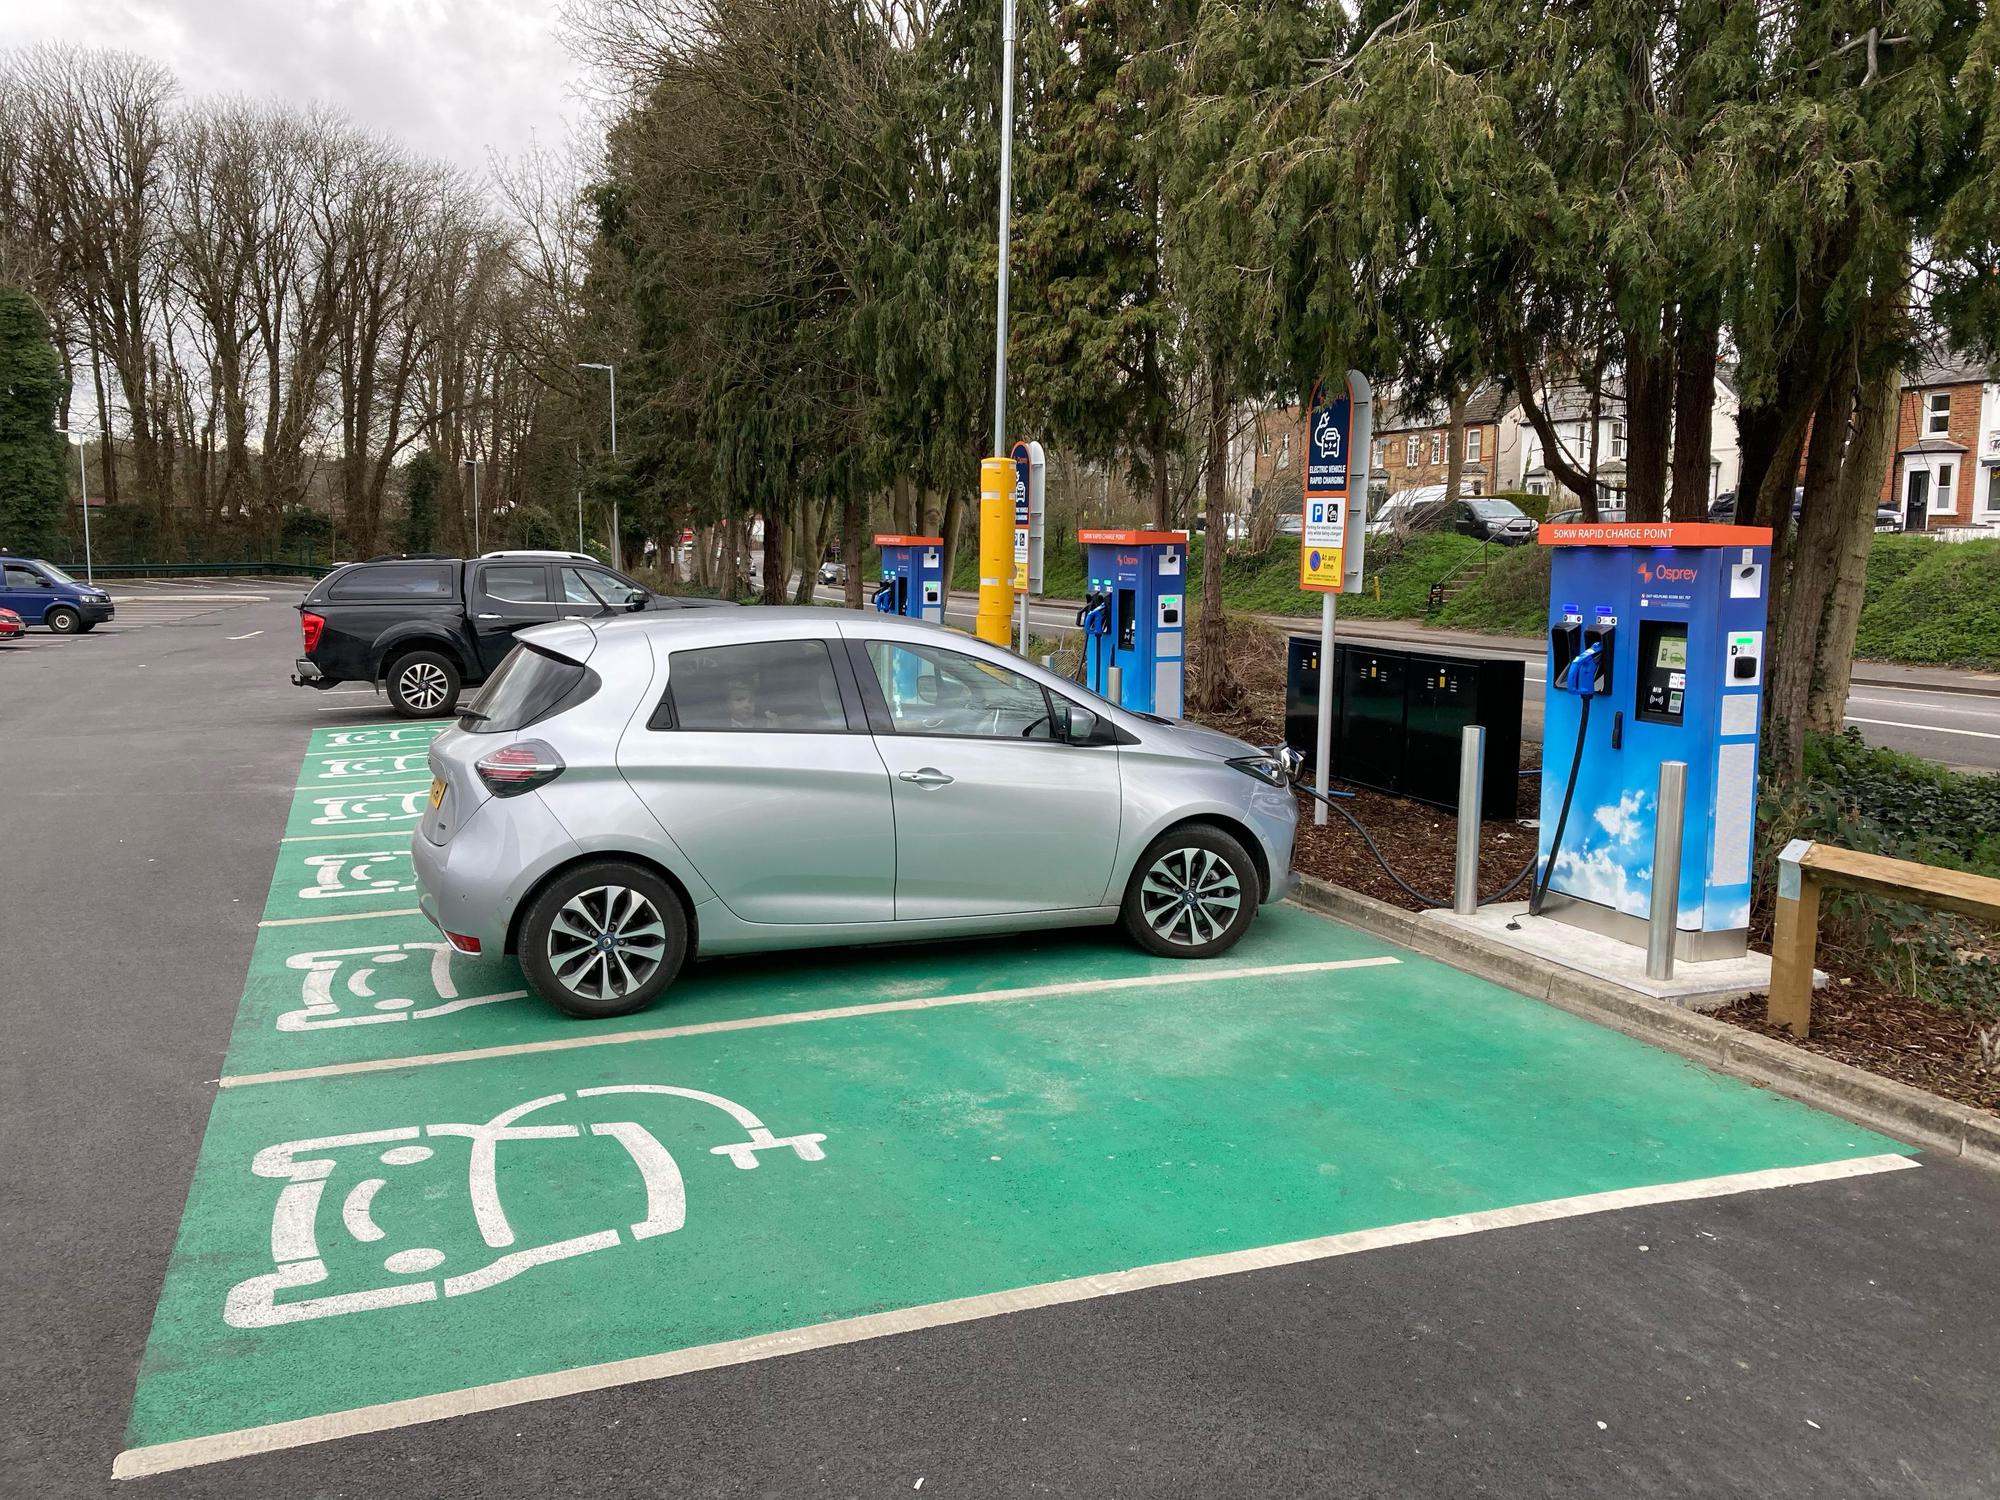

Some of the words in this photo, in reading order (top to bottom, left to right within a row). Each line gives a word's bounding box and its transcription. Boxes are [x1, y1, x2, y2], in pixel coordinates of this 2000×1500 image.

[1309, 465, 1328, 473] ELECTRIC
[1329, 465, 1346, 473] VEHICLE
[1310, 476, 1322, 484] RAPID
[1323, 476, 1344, 484] CHARGING
[1314, 505, 1322, 521] P
[1553, 528, 1577, 539] 50KW
[1578, 528, 1604, 539] RAPID
[1606, 528, 1641, 539] CHARGE
[1644, 528, 1674, 539] POINT
[1656, 564, 1698, 583] Osprey
